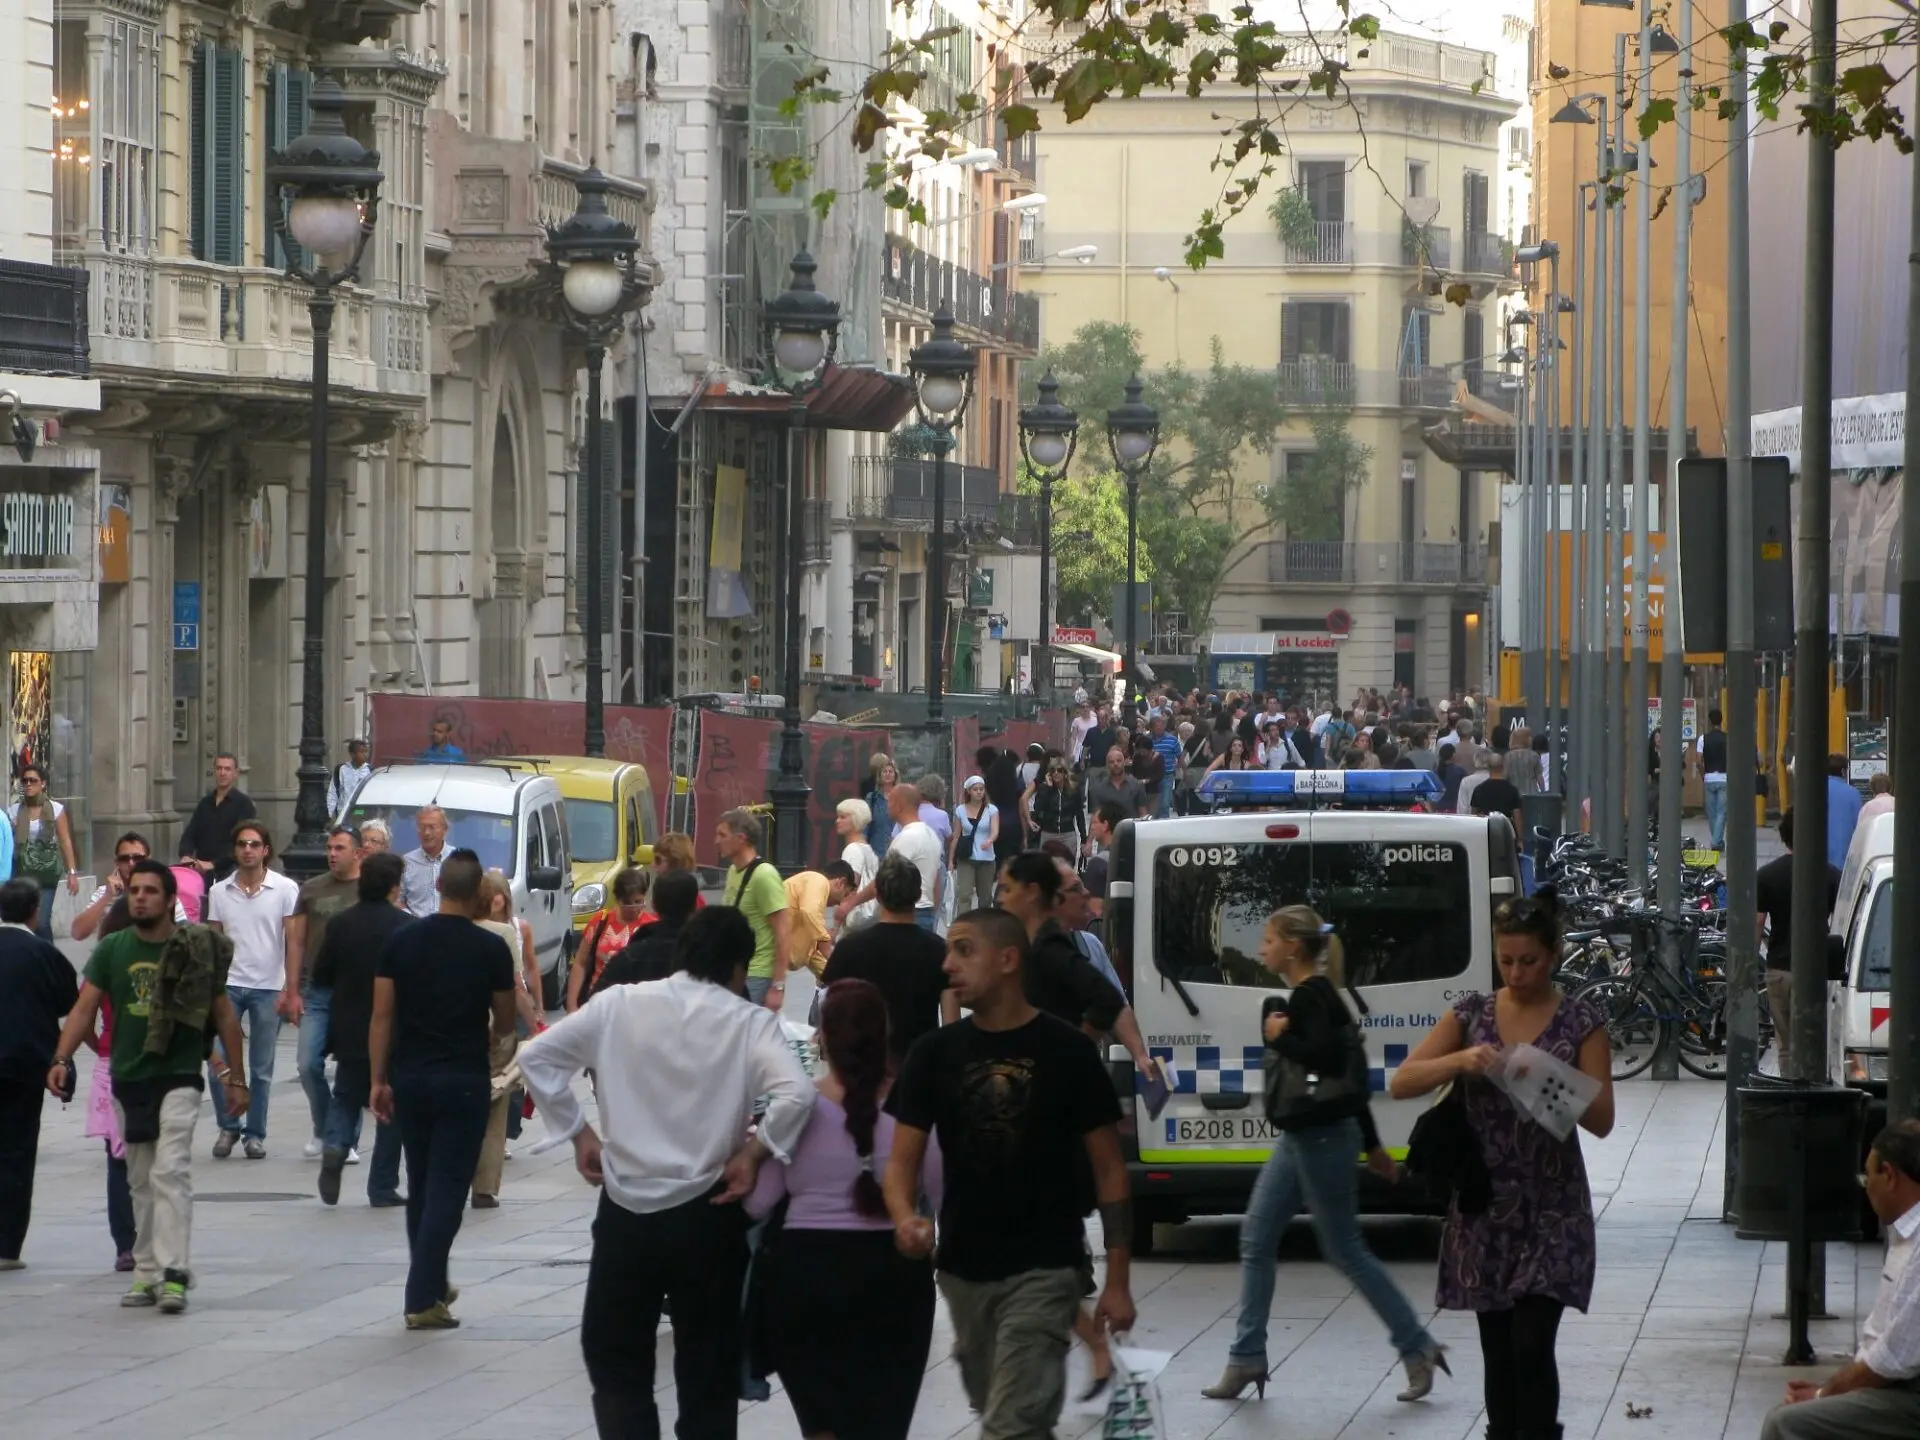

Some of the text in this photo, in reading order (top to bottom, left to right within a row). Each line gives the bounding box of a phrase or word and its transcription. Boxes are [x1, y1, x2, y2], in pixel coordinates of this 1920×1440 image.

[4, 492, 74, 556] SANTA ANA
[1277, 636, 1337, 648] ot Locker
[1300, 781, 1339, 789] BARCELONA
[1191, 847, 1238, 866] 092
[1384, 844, 1453, 866] policia
[1409, 1013, 1440, 1028] Urb
[1147, 1034, 1212, 1046] RENAULT
[1180, 1120, 1234, 1140] 6208
